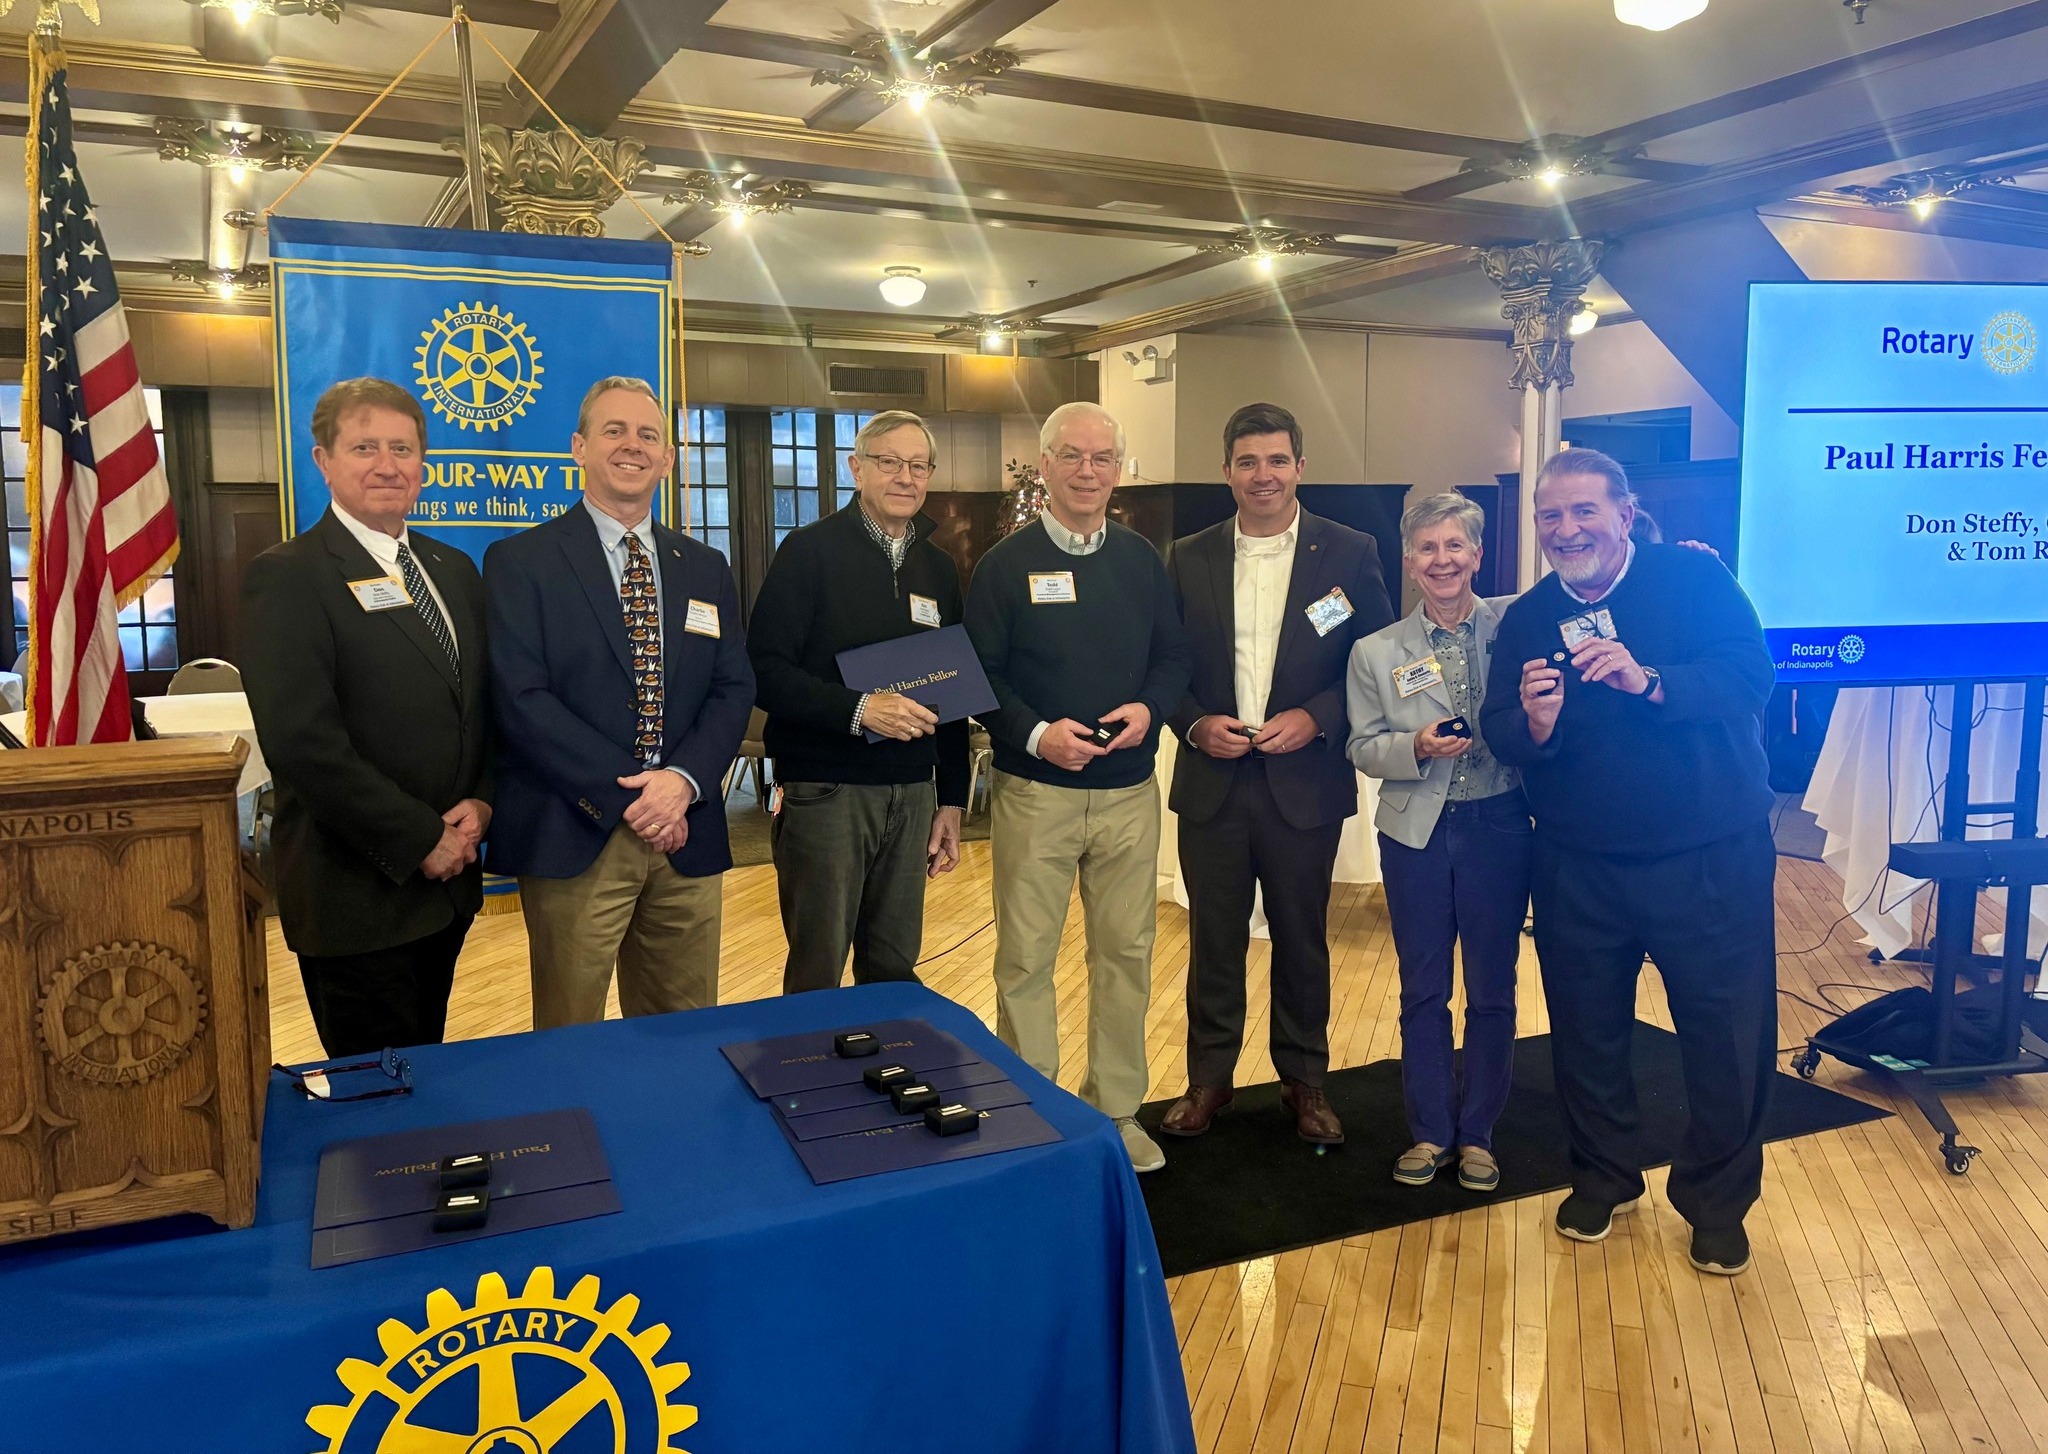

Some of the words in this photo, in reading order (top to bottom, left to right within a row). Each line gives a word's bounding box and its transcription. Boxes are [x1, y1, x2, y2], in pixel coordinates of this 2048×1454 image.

[453, 314, 505, 330] ROTARY
[1882, 326, 1974, 360] Rotary
[434, 385, 525, 419] INTERNATIONAL
[1824, 443, 1895, 470] Paul
[1903, 442, 2004, 469] Harris
[2012, 443, 2048, 468] Fe
[408, 501, 447, 520] ings
[455, 501, 478, 515] we
[486, 496, 535, 520] think,
[1905, 513, 1956, 535] Don
[1963, 511, 2039, 537] Steffy,
[1947, 542, 1967, 562] &
[1972, 541, 2026, 561] Tom
[1791, 643, 1836, 658] Rotary
[1777, 661, 1786, 669] of
[1787, 660, 1834, 670] Indianapolis
[874, 684, 896, 695] Paul
[896, 676, 928, 691] Harris
[928, 668, 958, 683] Fellow
[0, 810, 135, 838] NAPOLIS
[77, 952, 157, 976] ROTARY
[61, 1041, 192, 1080] INTERNATIONAL
[512, 1142, 552, 1158] Paul
[374, 1161, 438, 1177] Fellow
[407, 1311, 579, 1379] ROTARY
